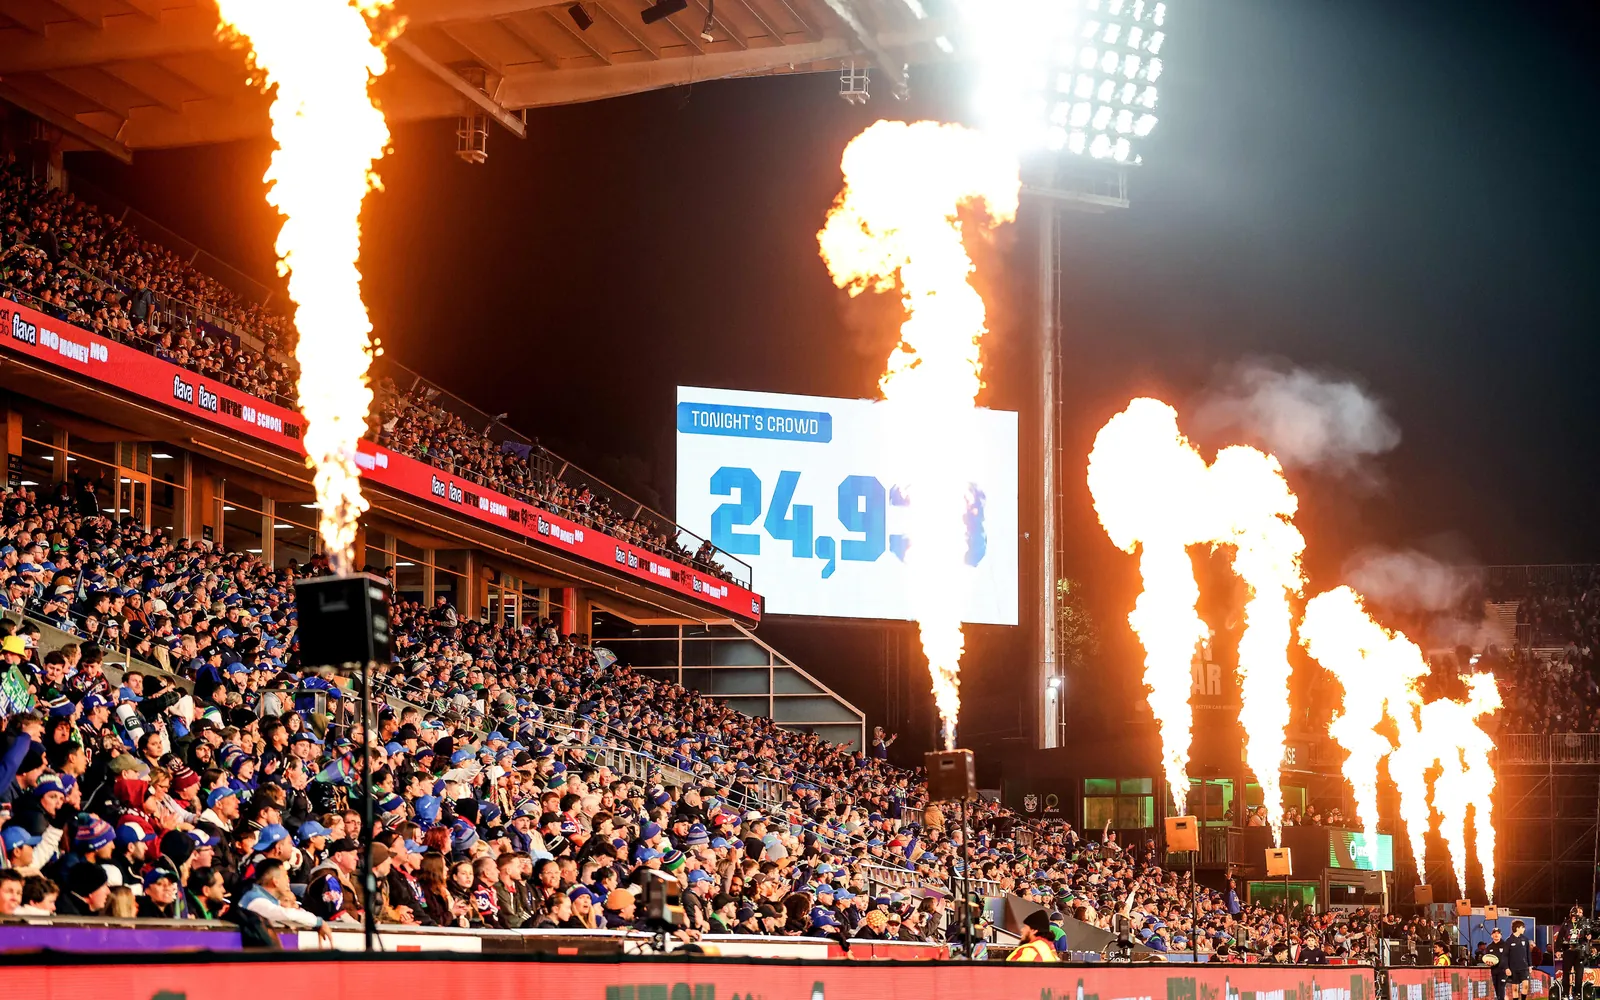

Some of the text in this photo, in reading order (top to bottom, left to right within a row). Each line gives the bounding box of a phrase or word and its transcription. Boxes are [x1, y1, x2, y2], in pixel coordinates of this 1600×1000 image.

[12, 312, 108, 364] flava MO MONEY MO
[174, 374, 193, 404] flava
[198, 383, 217, 413] flava
[242, 405, 256, 424] OLD
[257, 412, 282, 433] SCHOOL
[691, 410, 819, 435] TONIGHT'S CROWD
[1190, 663, 1222, 696] AR
